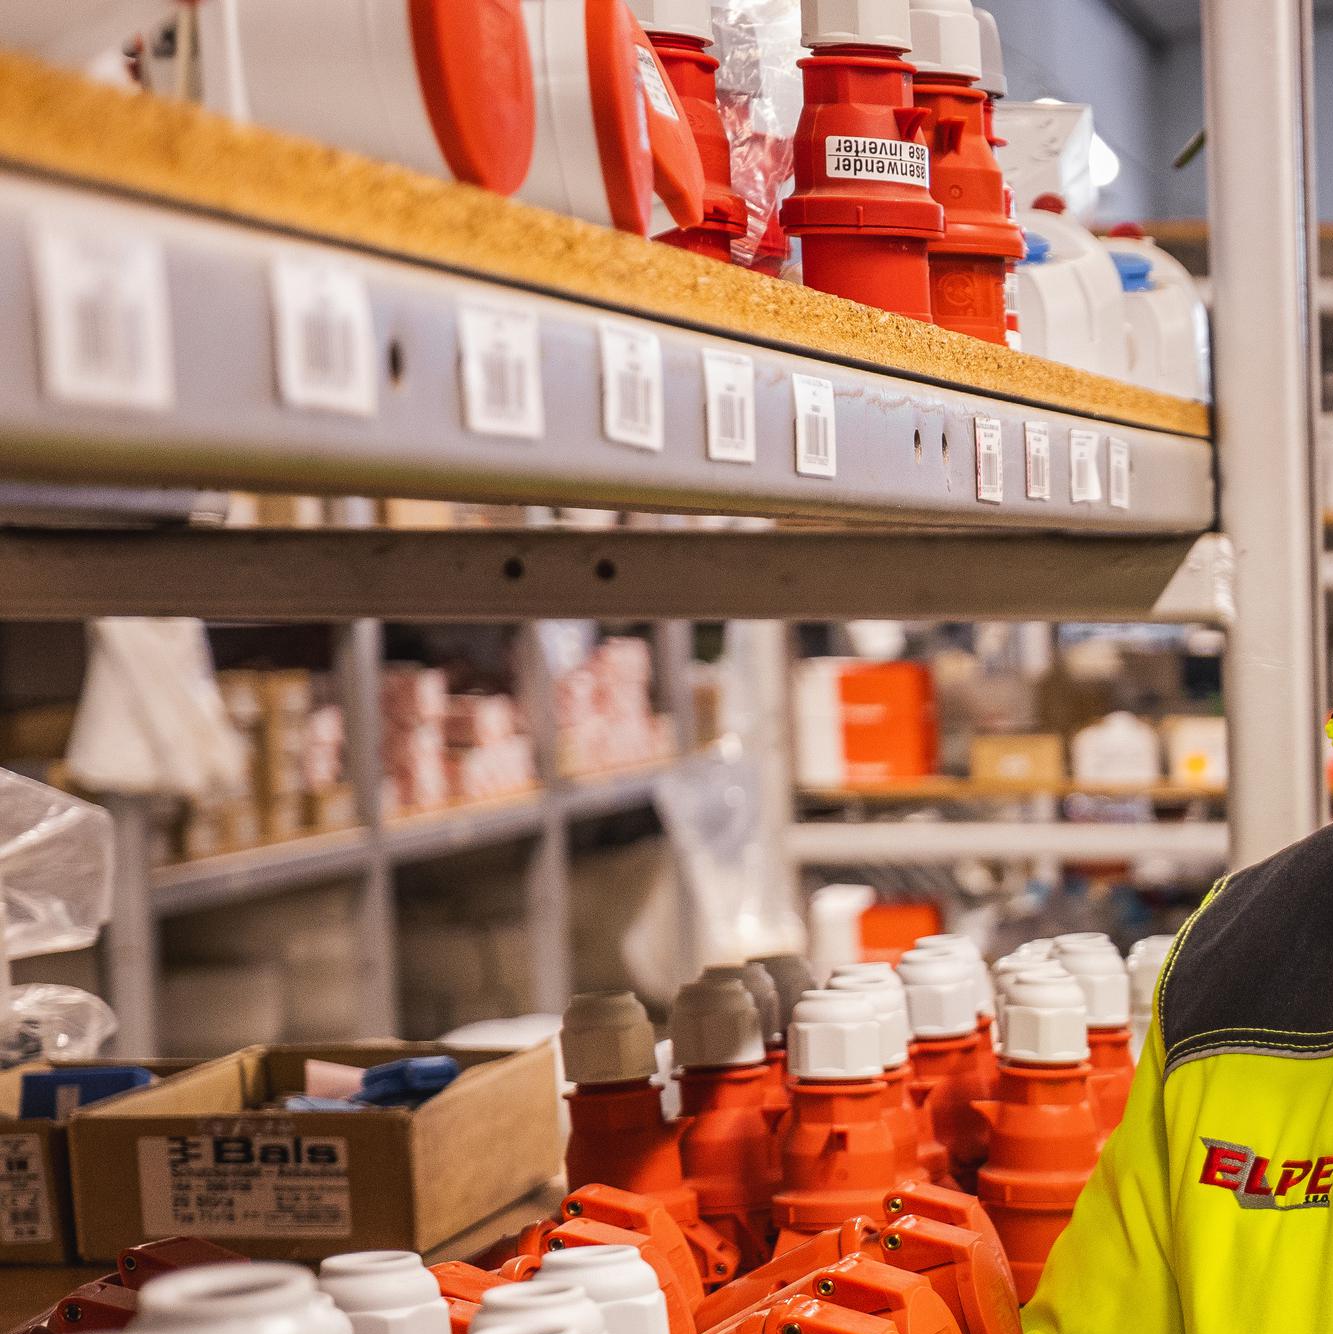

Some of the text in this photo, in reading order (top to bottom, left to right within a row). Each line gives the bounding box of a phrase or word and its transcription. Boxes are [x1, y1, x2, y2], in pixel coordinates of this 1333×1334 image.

[836, 138, 902, 160] inverter
[834, 157, 926, 179] asenwender
[213, 1136, 338, 1164] Bals
